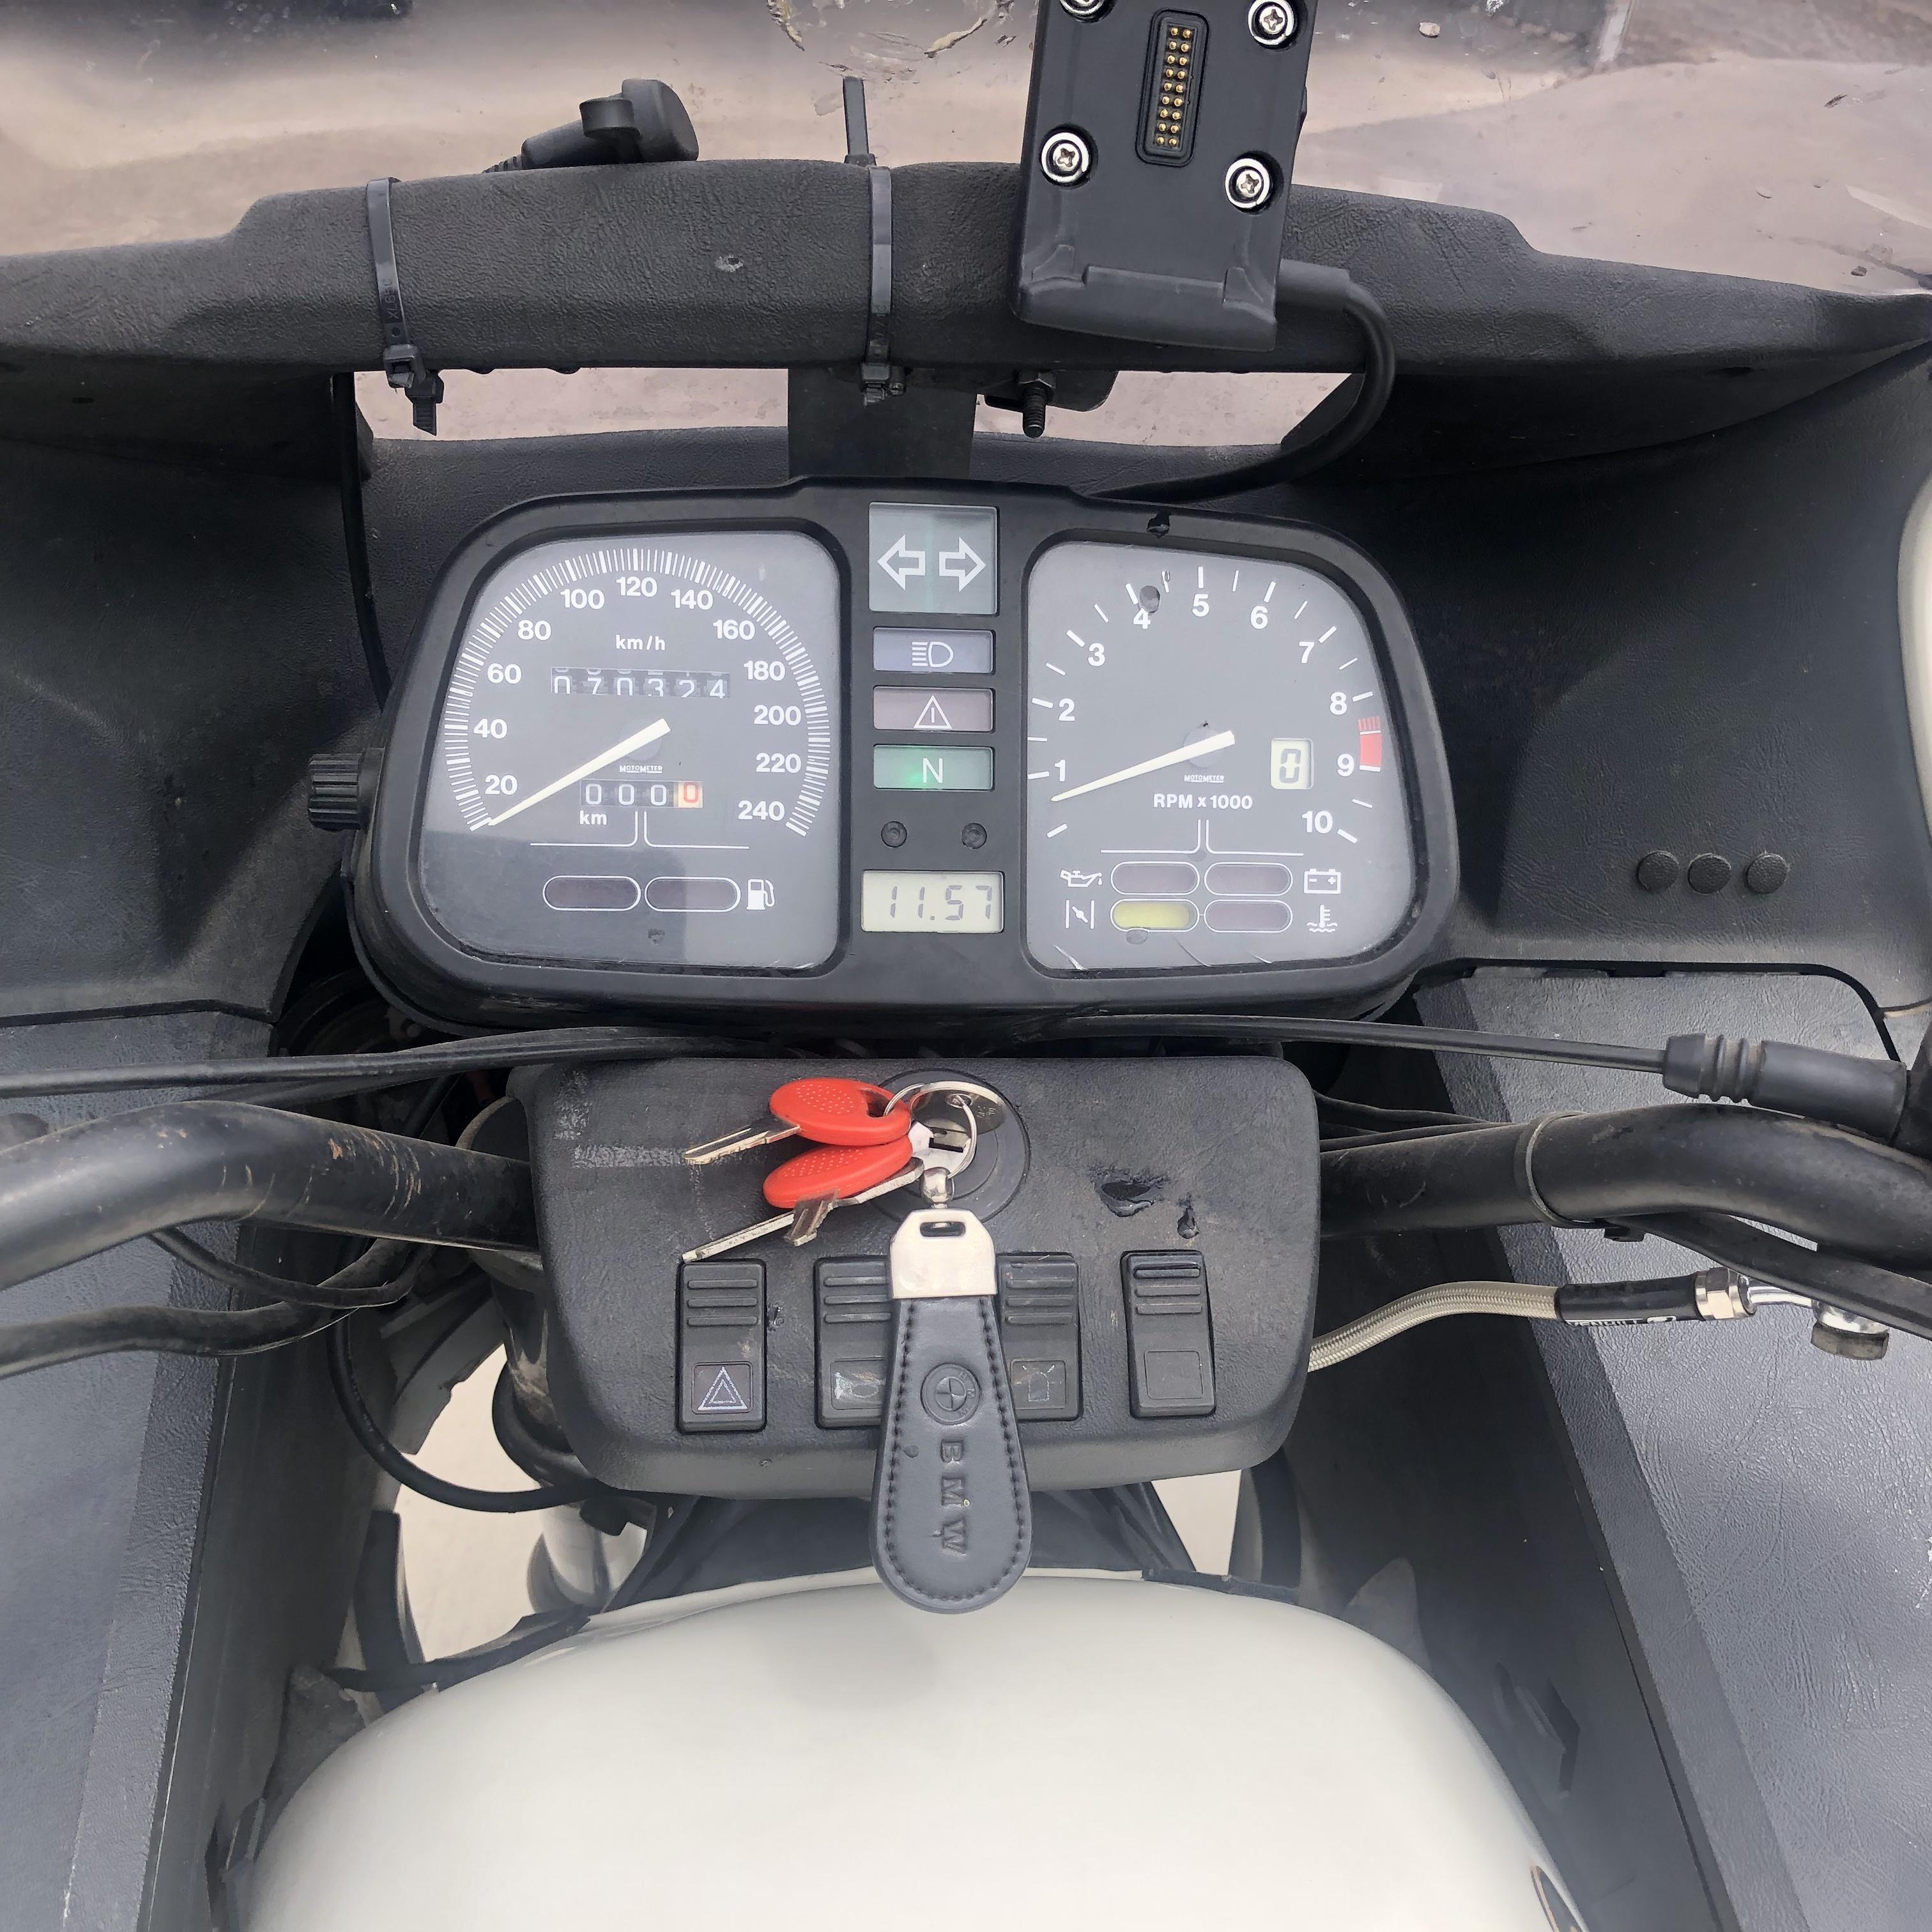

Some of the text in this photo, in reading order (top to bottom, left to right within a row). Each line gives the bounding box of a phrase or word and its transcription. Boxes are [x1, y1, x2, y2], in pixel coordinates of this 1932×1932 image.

[616, 576, 657, 597] 120
[560, 588, 605, 610] 100
[670, 589, 714, 610] 140
[1192, 594, 1210, 617] 5
[1133, 608, 1151, 629] 4
[1250, 608, 1268, 629] 6
[517, 619, 551, 641] 80
[712, 619, 756, 640] 160
[615, 634, 666, 650] km/h
[1299, 641, 1315, 664] 7
[1087, 643, 1105, 666] 3
[487, 663, 522, 684] 60
[743, 661, 786, 681] 180
[1058, 698, 1075, 721] 2
[1330, 691, 1347, 716] 8
[754, 705, 802, 726] 200
[473, 718, 507, 739] 40
[756, 753, 802, 774] 220
[922, 758, 943, 783] N
[1054, 759, 1066, 782] 1
[1279, 748, 1301, 783] 0
[1337, 753, 1354, 777] 9
[485, 774, 518, 795] 20
[738, 800, 785, 821] 240
[1153, 793, 1193, 809] RPM
[579, 809, 607, 825] km
[1301, 810, 1333, 834] 10
[890, 885, 992, 921] 11.57
[940, 1439, 967, 1554] BMW
